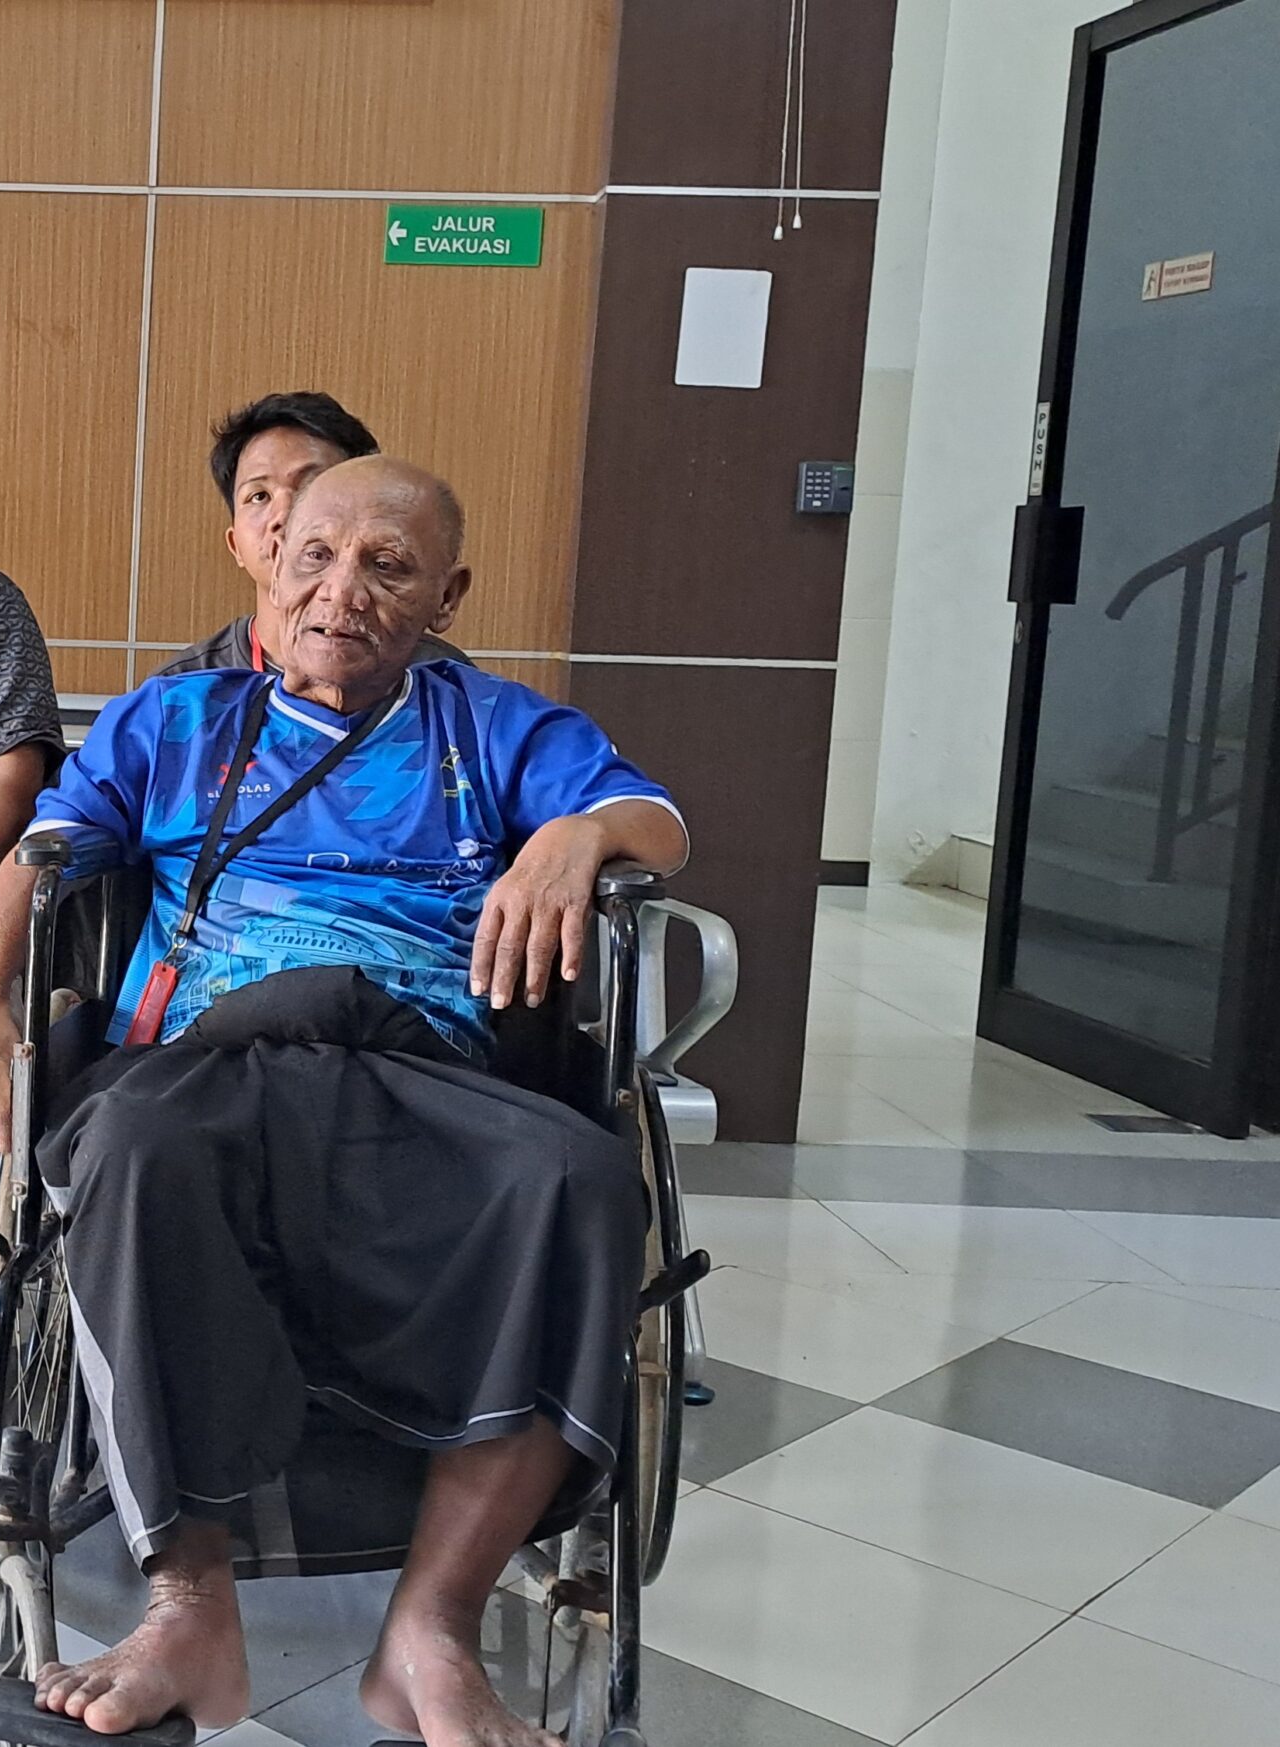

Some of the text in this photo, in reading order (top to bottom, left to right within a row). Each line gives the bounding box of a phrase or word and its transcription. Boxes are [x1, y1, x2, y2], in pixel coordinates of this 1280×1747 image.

[432, 216, 495, 232] JALUR
[414, 237, 511, 255] EVAKUASI
[1034, 413, 1047, 471] PUSH
